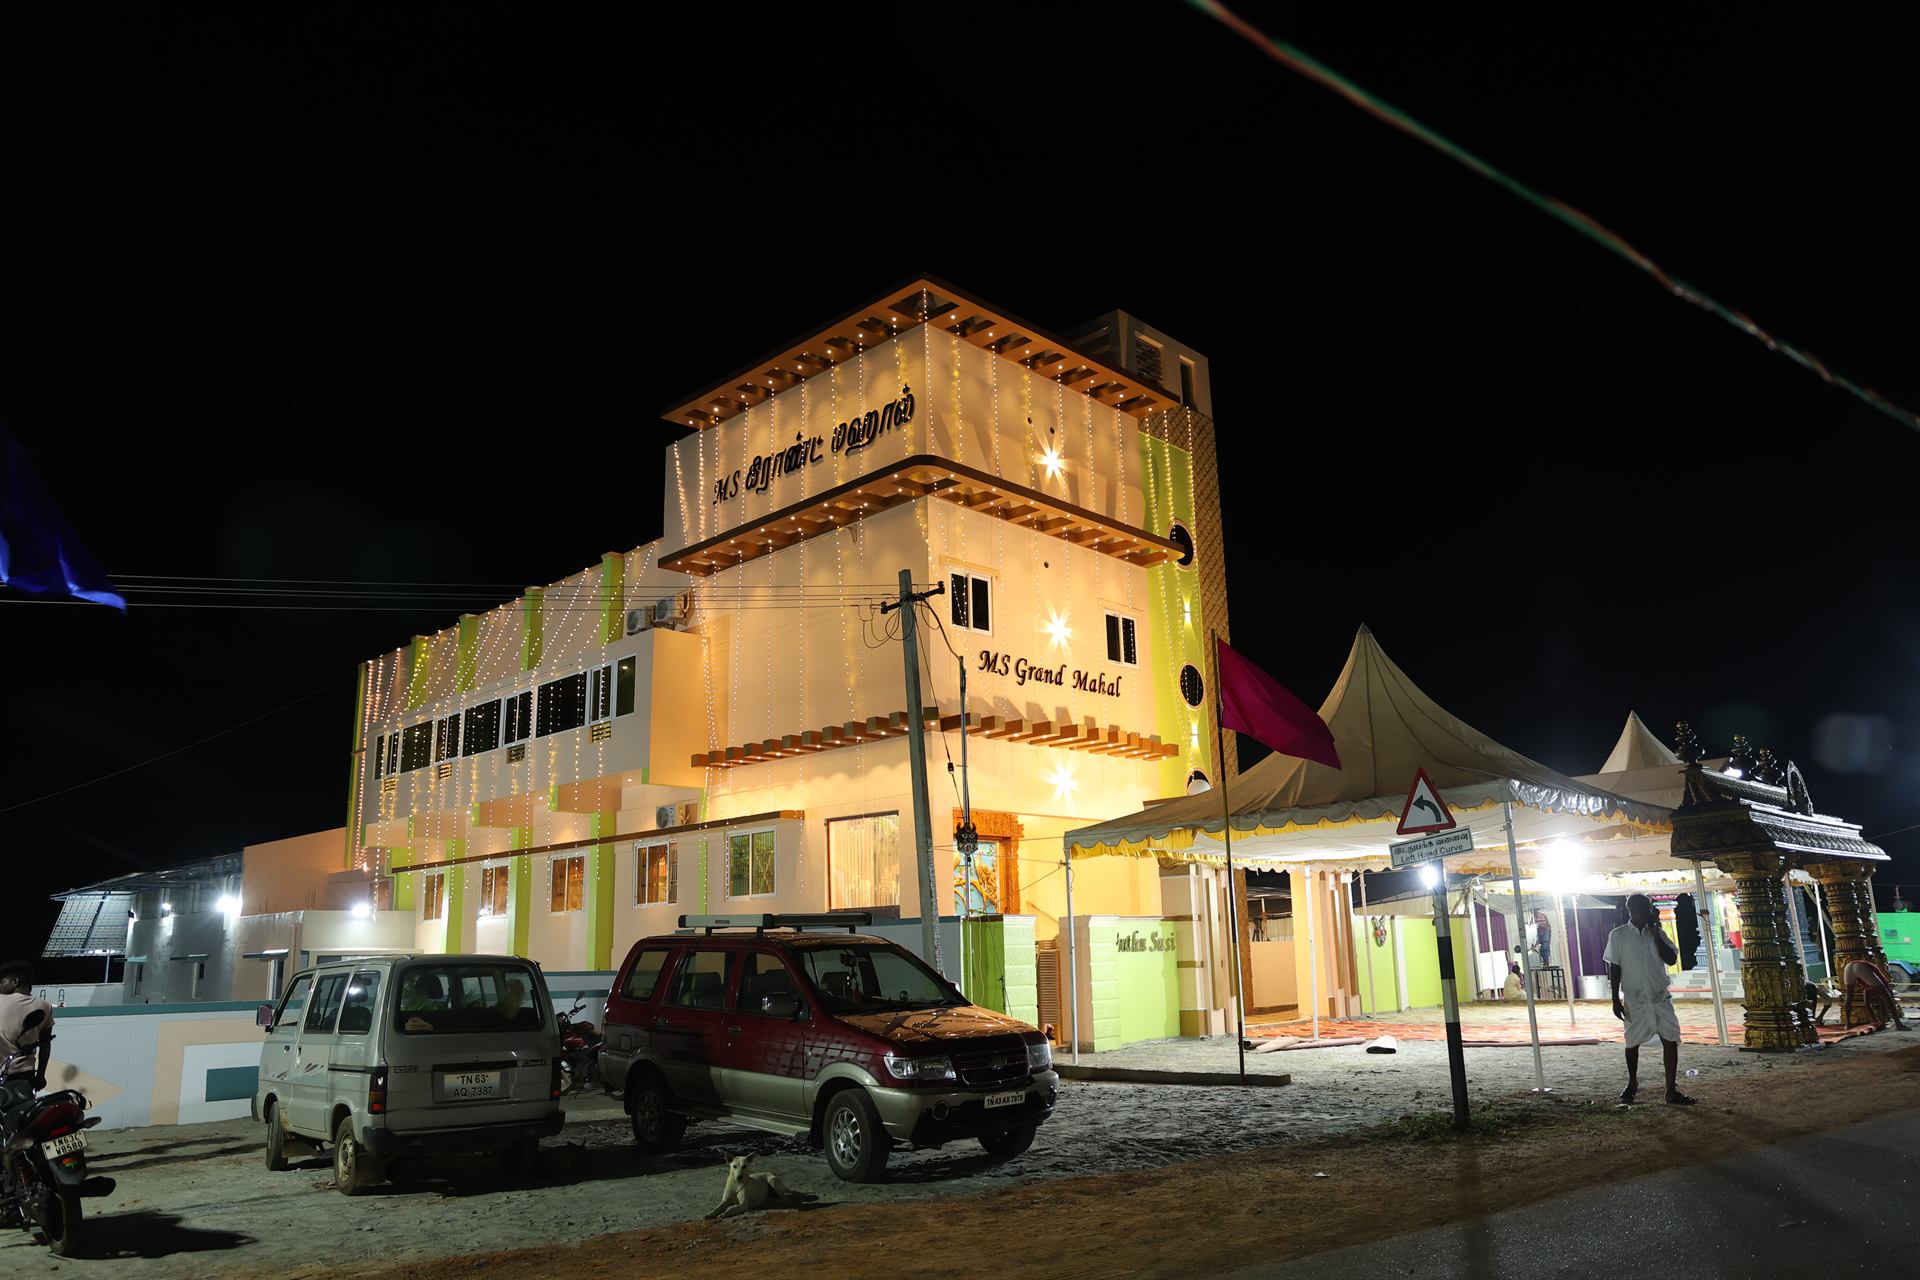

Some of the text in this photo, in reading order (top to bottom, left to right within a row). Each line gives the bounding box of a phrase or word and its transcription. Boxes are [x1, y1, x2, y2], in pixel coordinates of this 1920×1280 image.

[830, 383, 915, 457] மஹால்
[978, 650, 1122, 698] MS Grand Mahal
[1401, 853, 1416, 863] Left
[1440, 844, 1463, 856] Curve
[460, 1074, 487, 1085] TN 63
[453, 1086, 493, 1097] AQ 7387
